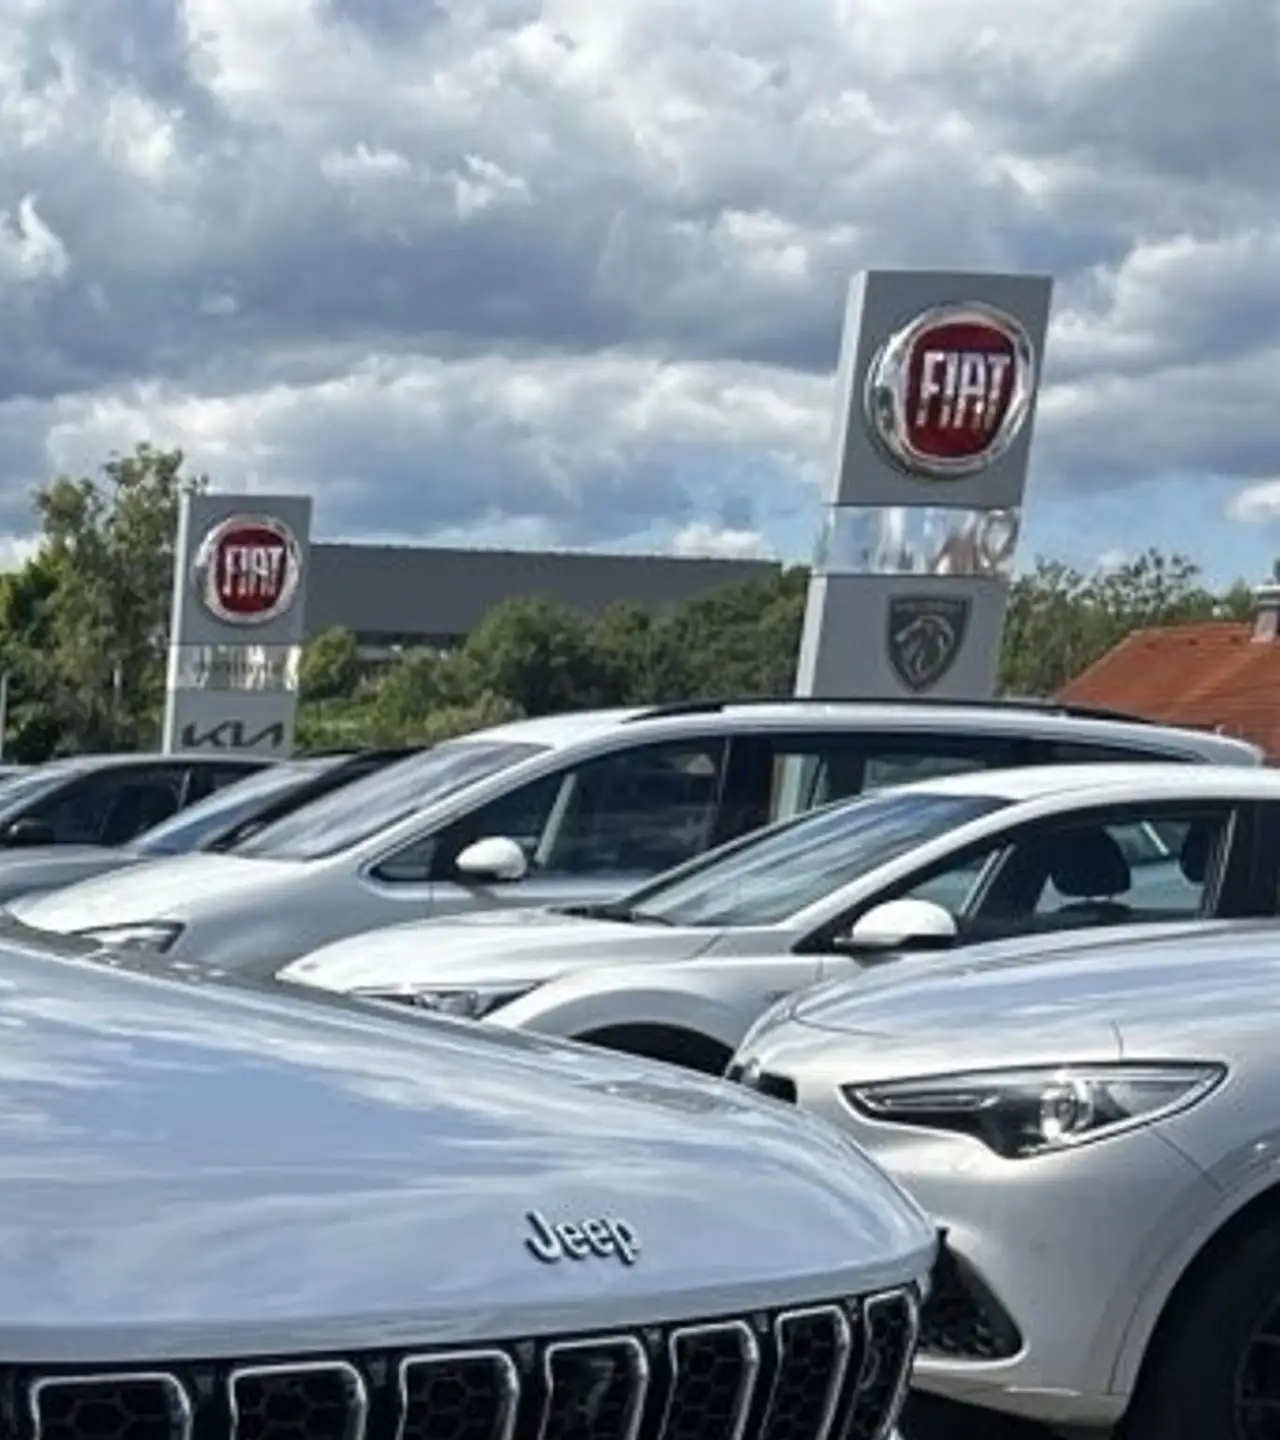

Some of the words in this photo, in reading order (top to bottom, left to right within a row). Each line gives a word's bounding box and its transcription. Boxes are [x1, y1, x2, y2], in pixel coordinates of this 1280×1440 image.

[916, 349, 1011, 430] FIAT
[222, 546, 284, 598] FIAT
[524, 1209, 642, 1267] Jeep
